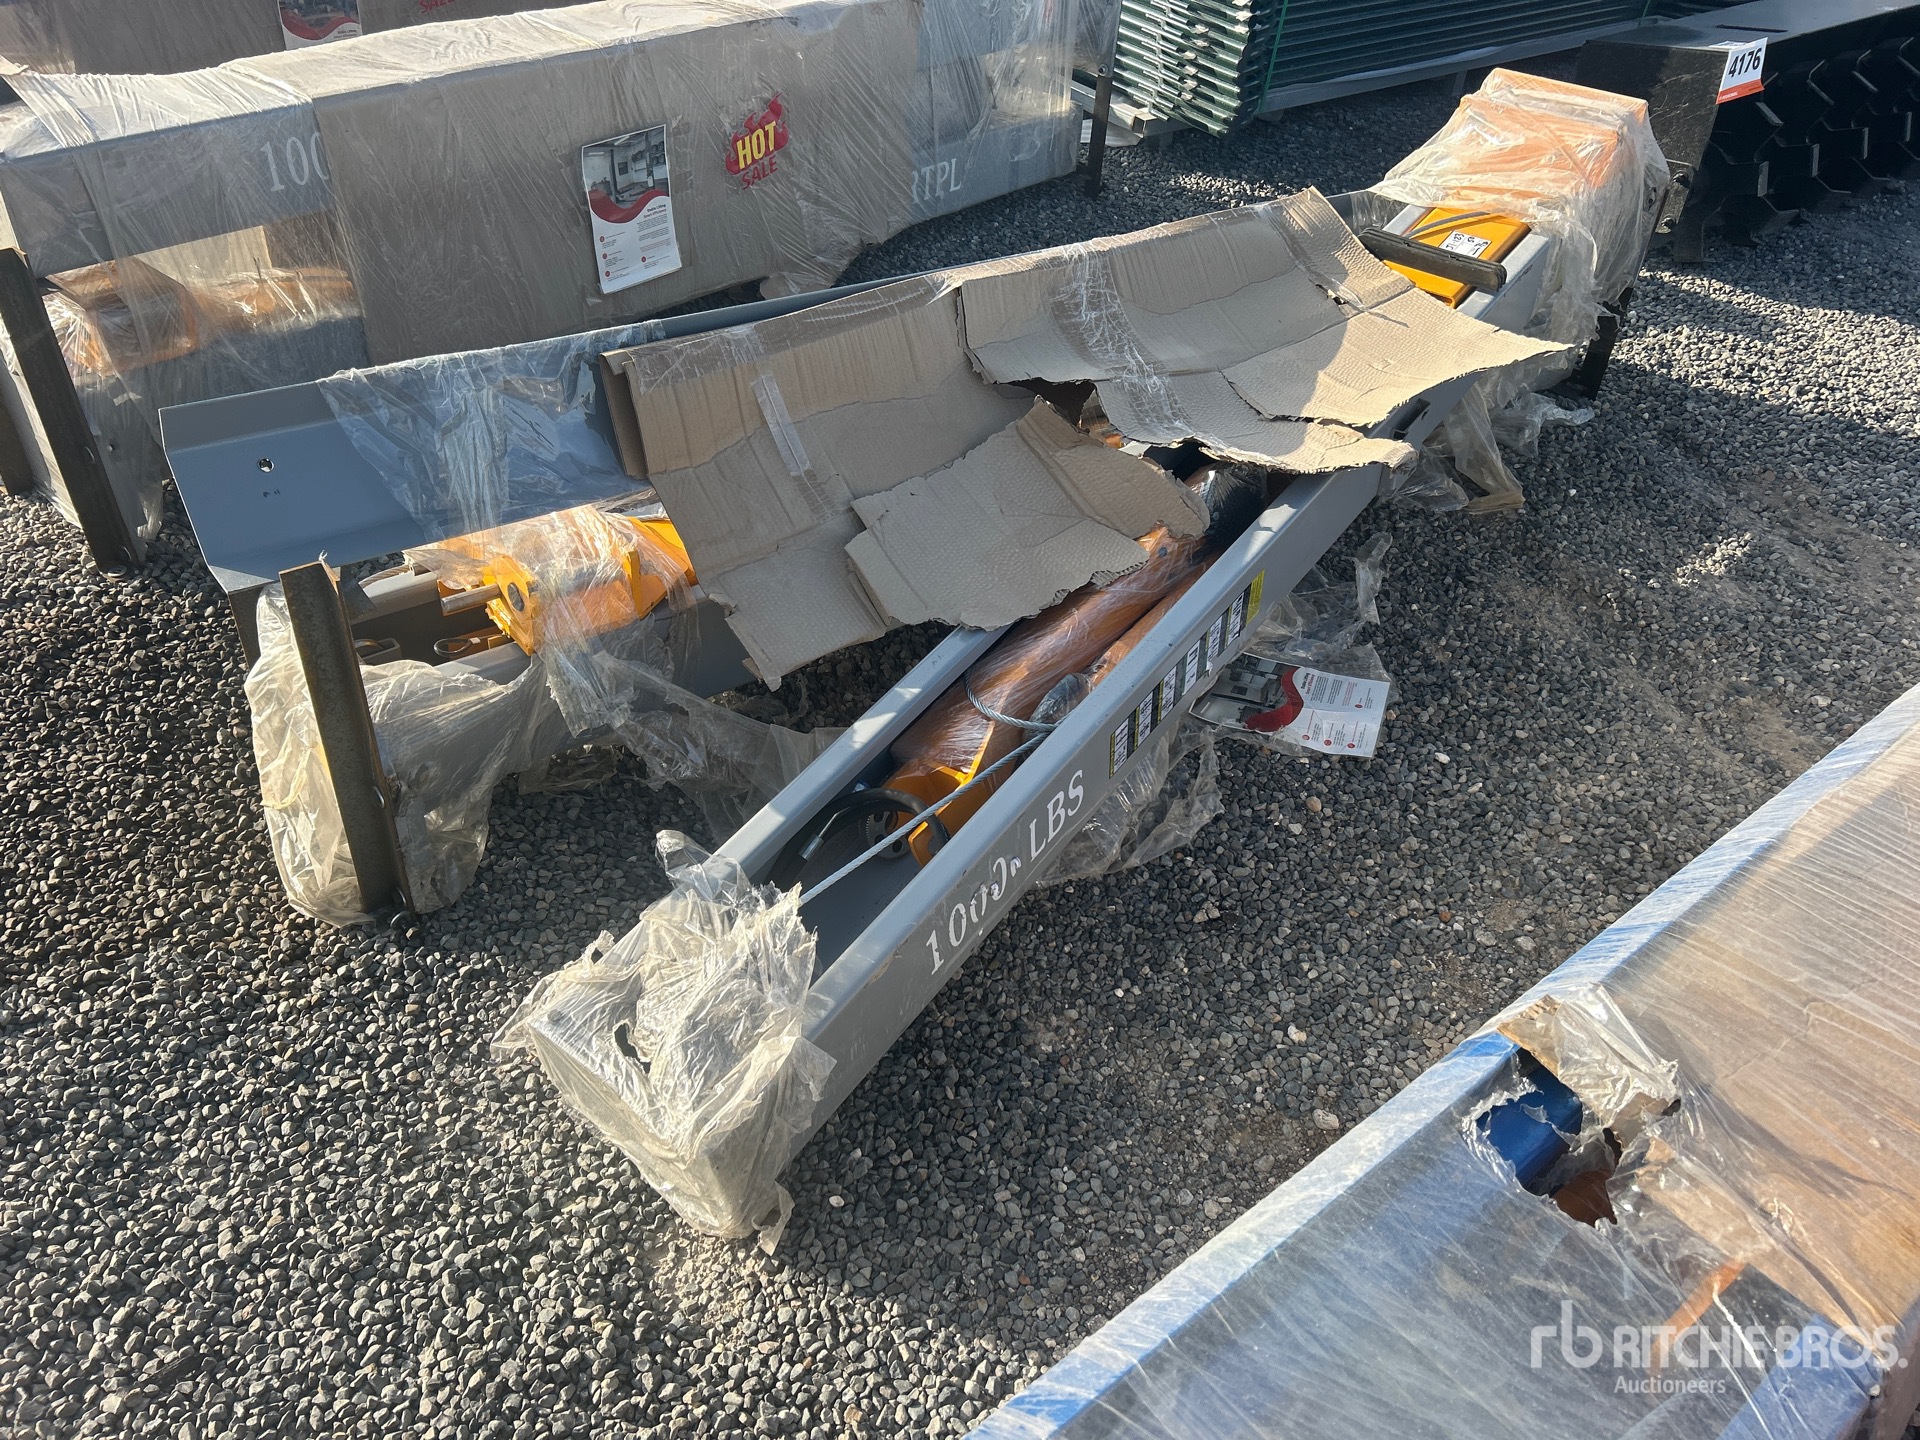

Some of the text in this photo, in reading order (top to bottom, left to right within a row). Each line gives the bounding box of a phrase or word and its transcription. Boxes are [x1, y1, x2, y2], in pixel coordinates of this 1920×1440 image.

[1728, 47, 1762, 78] 4176
[736, 120, 777, 170] HOT
[741, 154, 778, 191] SALE
[1029, 769, 1084, 863] LBS
